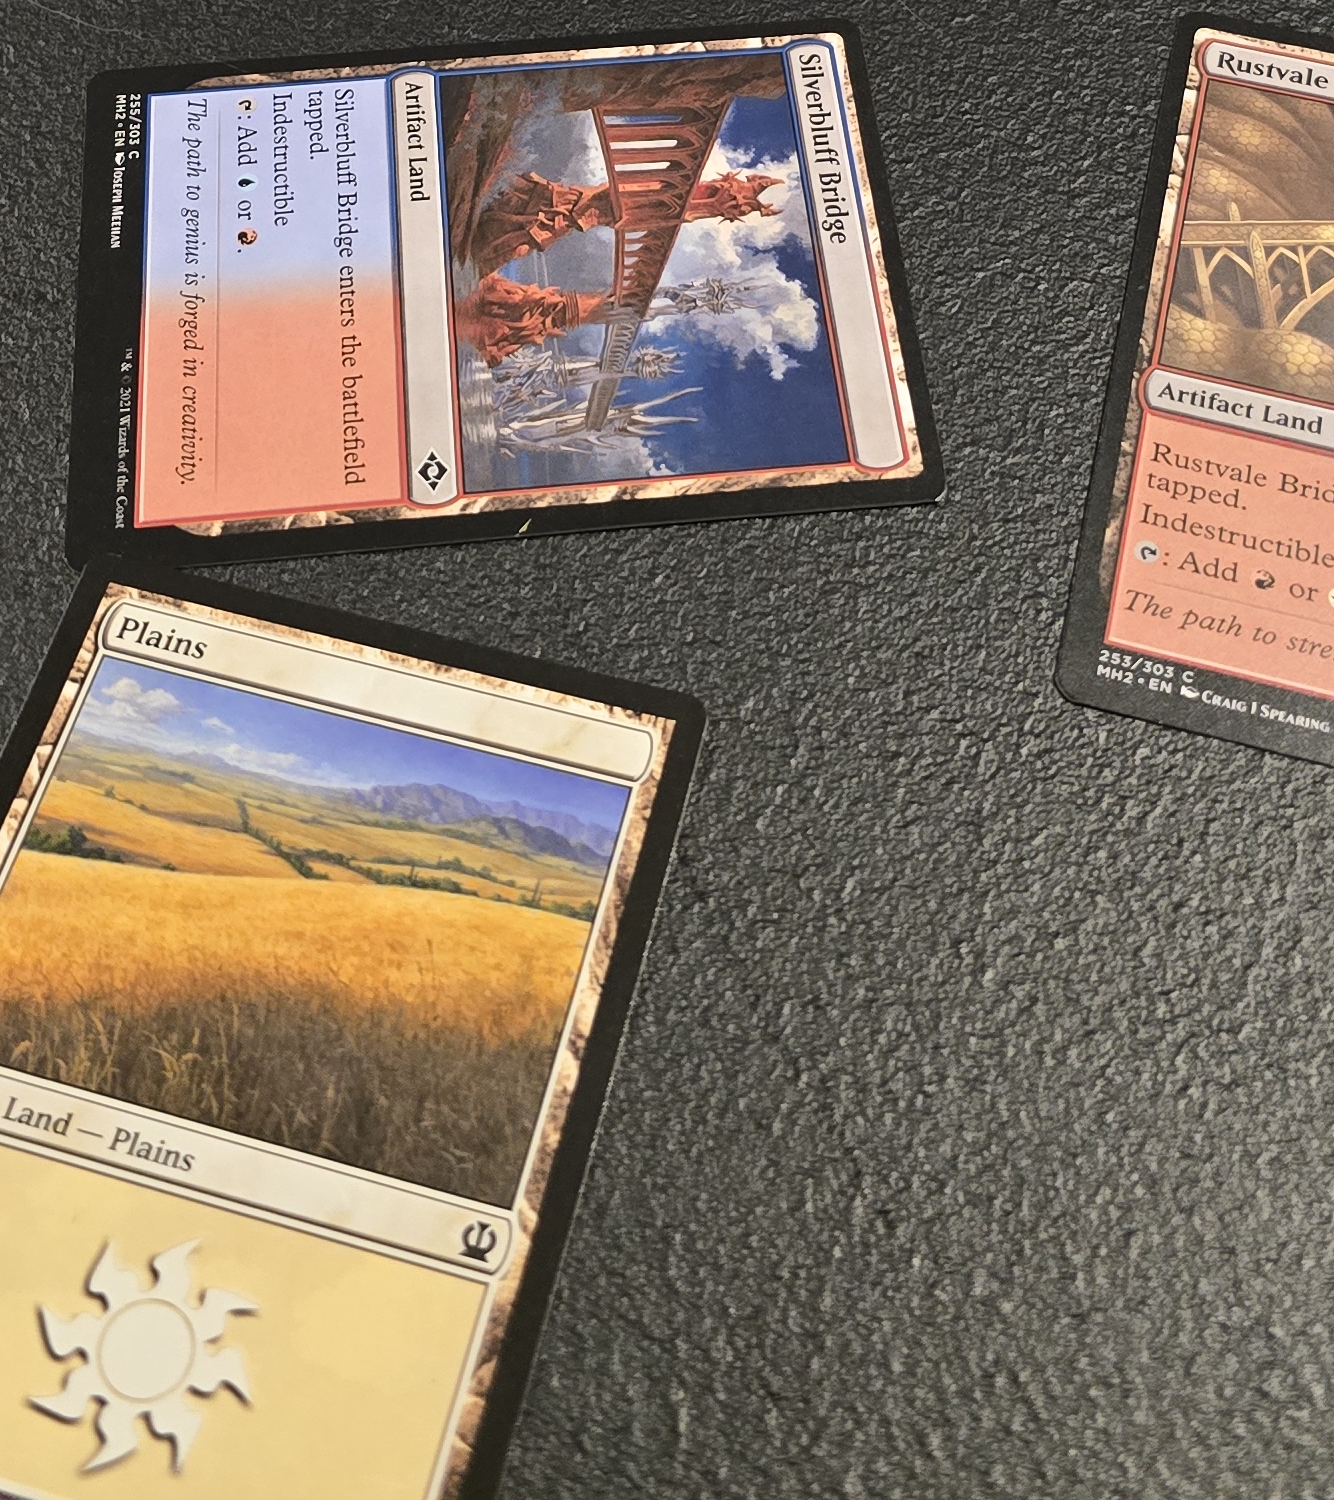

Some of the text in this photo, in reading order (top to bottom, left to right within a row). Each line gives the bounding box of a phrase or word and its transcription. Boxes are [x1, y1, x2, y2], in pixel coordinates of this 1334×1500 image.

[1215, 50, 1329, 92] Rustvale
[127, 93, 142, 159] 255/303 C
[271, 92, 293, 226] Indestructible
[302, 90, 327, 160] tapped.
[403, 81, 428, 202] Artifact Land
[795, 52, 853, 245] Silverbluff Bridge
[236, 125, 255, 220] Add or
[175, 98, 206, 485] The path to genius is forged in creativity.
[331, 88, 365, 485] Silverbluff Bridge enters the battlefield
[1157, 381, 1323, 435] Artifact Land
[114, 387, 132, 529] 2021 Wizards of the Coast
[1144, 470, 1249, 514] tapped.
[1149, 442, 1269, 488] Rustvale
[1177, 551, 1319, 603] Add or
[113, 615, 211, 660] Plains
[1123, 589, 1174, 621] The
[1180, 605, 1244, 645] path
[1252, 625, 1277, 646] to
[1097, 648, 1195, 684] 253/303 C
[1, 1096, 75, 1137] Land
[106, 1127, 198, 1174] Plains
